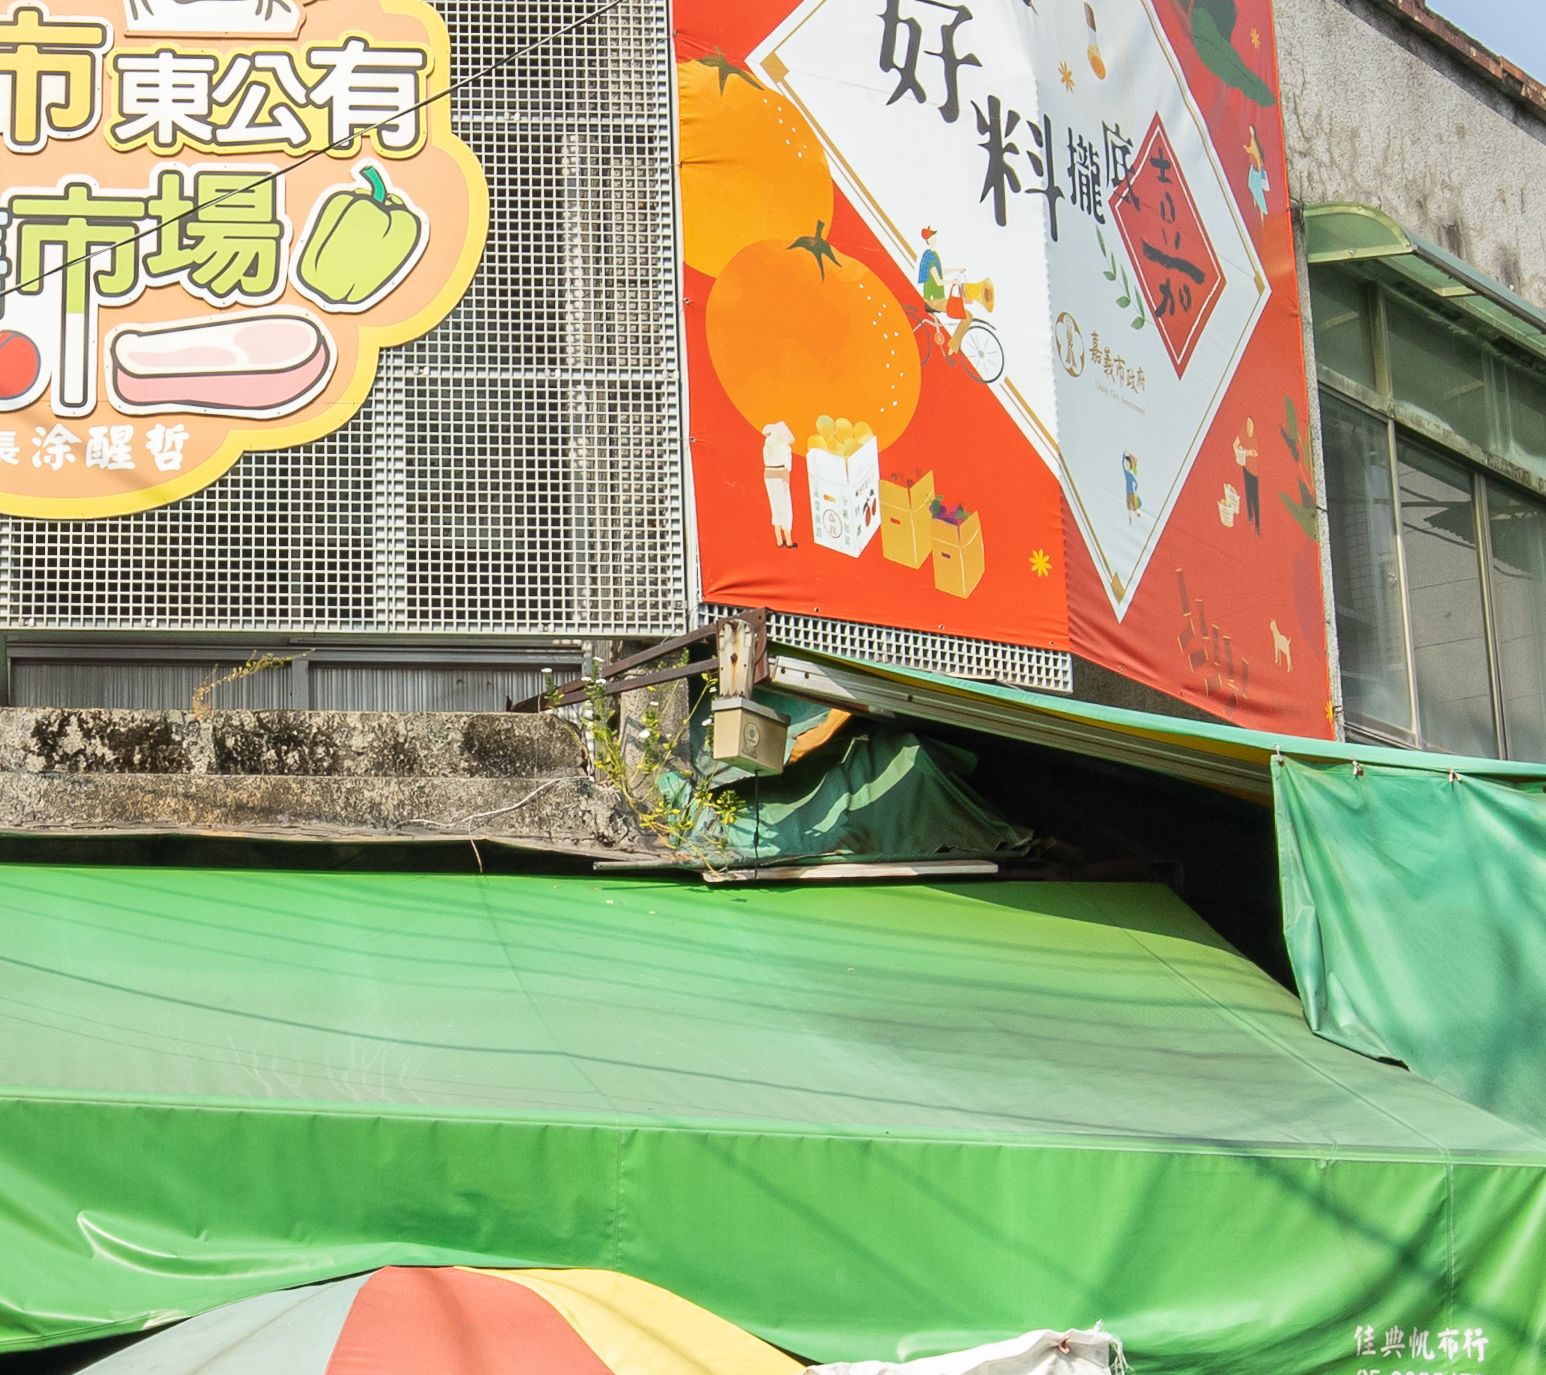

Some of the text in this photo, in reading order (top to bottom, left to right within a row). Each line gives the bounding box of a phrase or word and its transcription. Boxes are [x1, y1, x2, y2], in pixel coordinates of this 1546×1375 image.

[30, 422, 192, 473] 涂醒哲
[1353, 1324, 1490, 1363] 佳典帆布行
